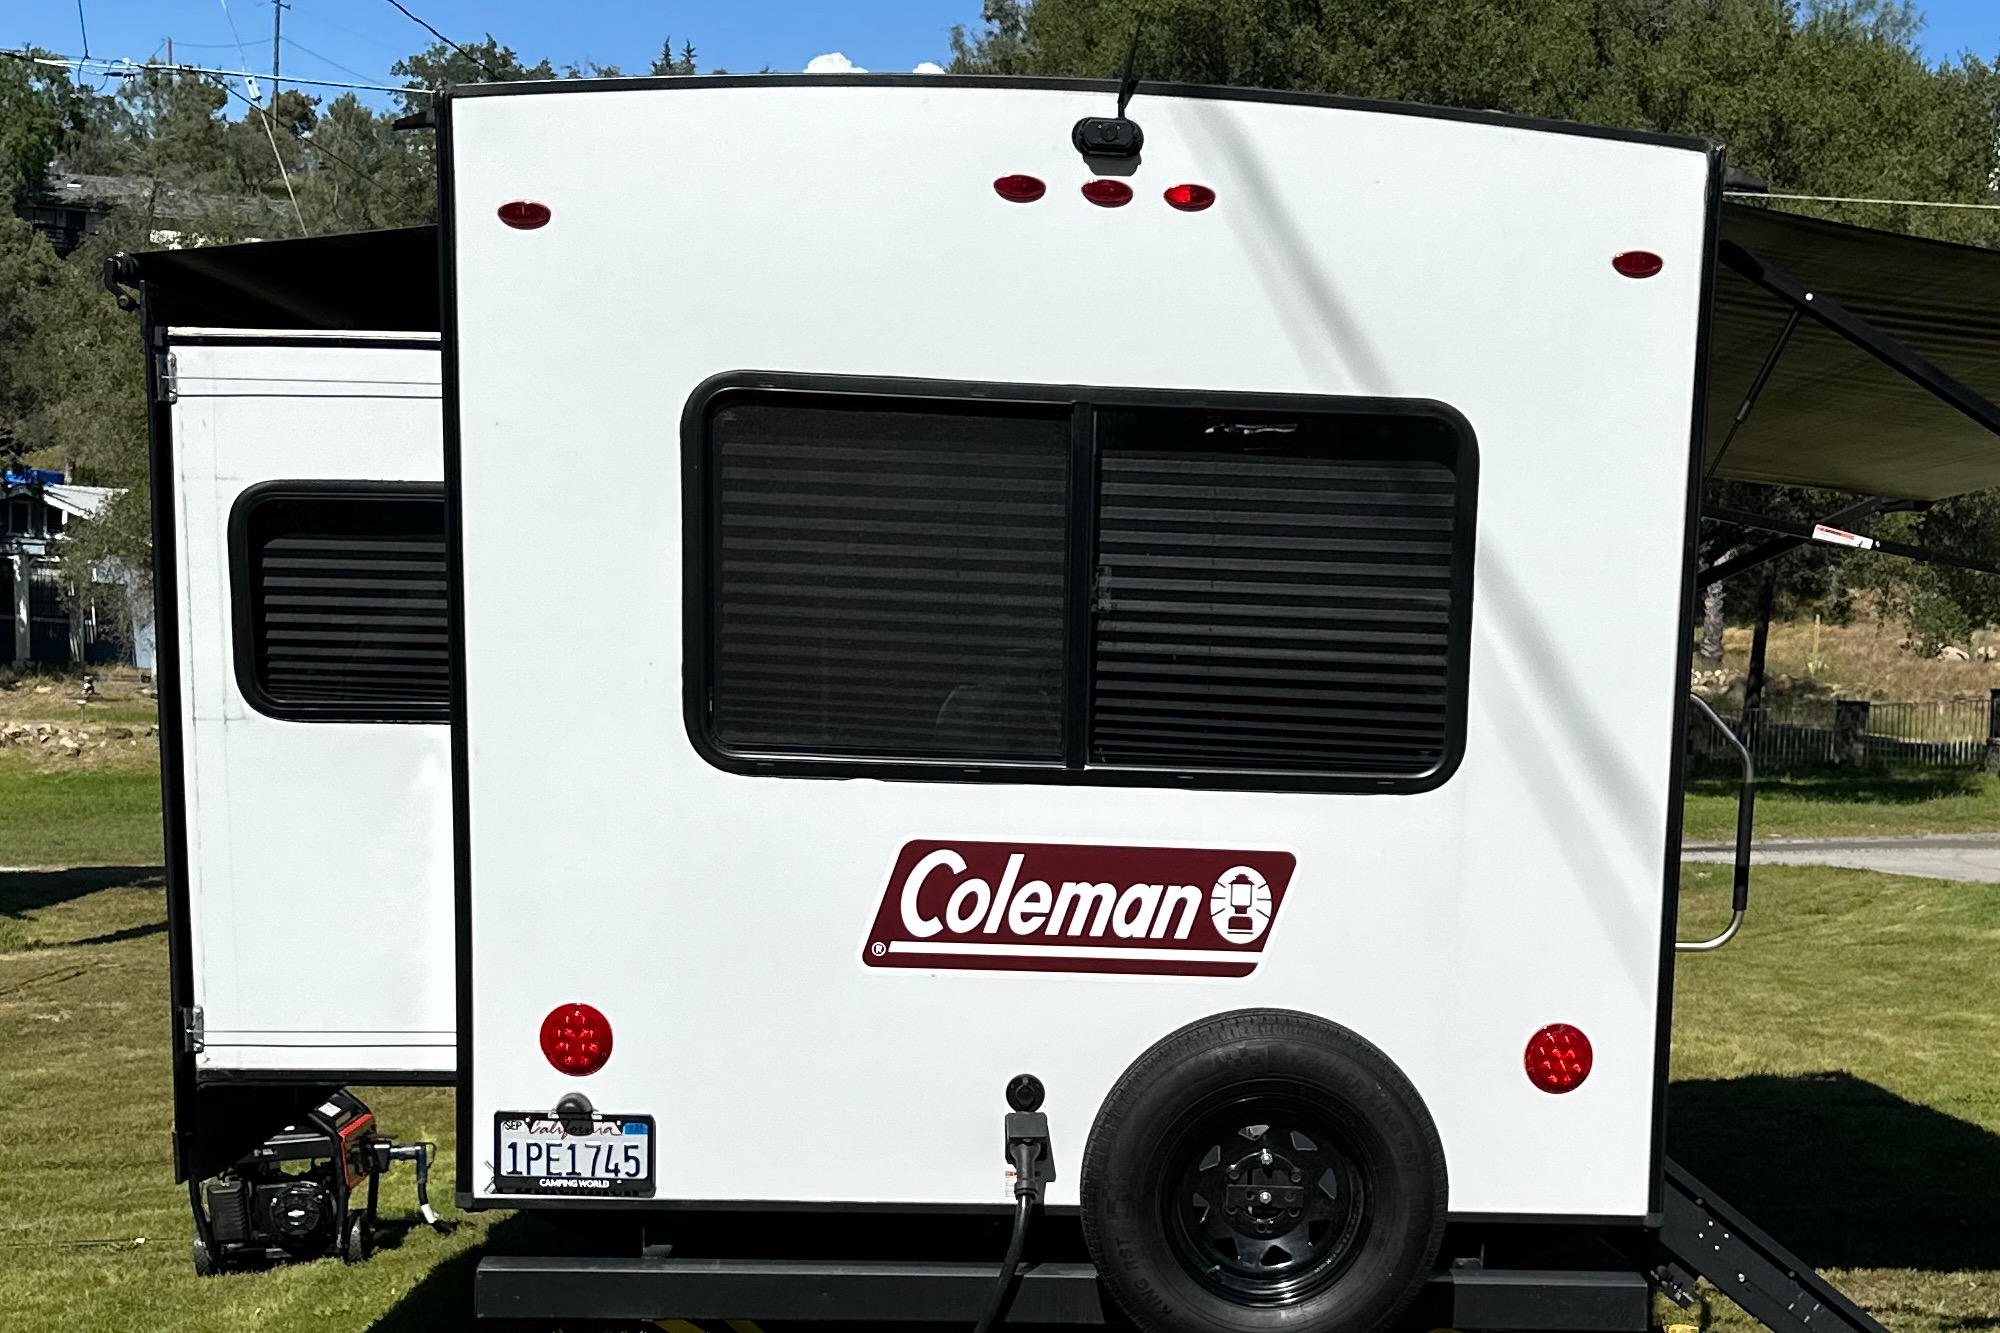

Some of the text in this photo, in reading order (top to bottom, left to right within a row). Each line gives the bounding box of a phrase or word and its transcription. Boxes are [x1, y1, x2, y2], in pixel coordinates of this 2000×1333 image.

[901, 849, 1203, 940] Coleman
[504, 1120, 522, 1131] SEP
[529, 1120, 623, 1140] California
[506, 1142, 641, 1178] 1PE1745
[539, 1179, 610, 1188] CAMPING WORLD
[1115, 1236, 1140, 1270] RST
